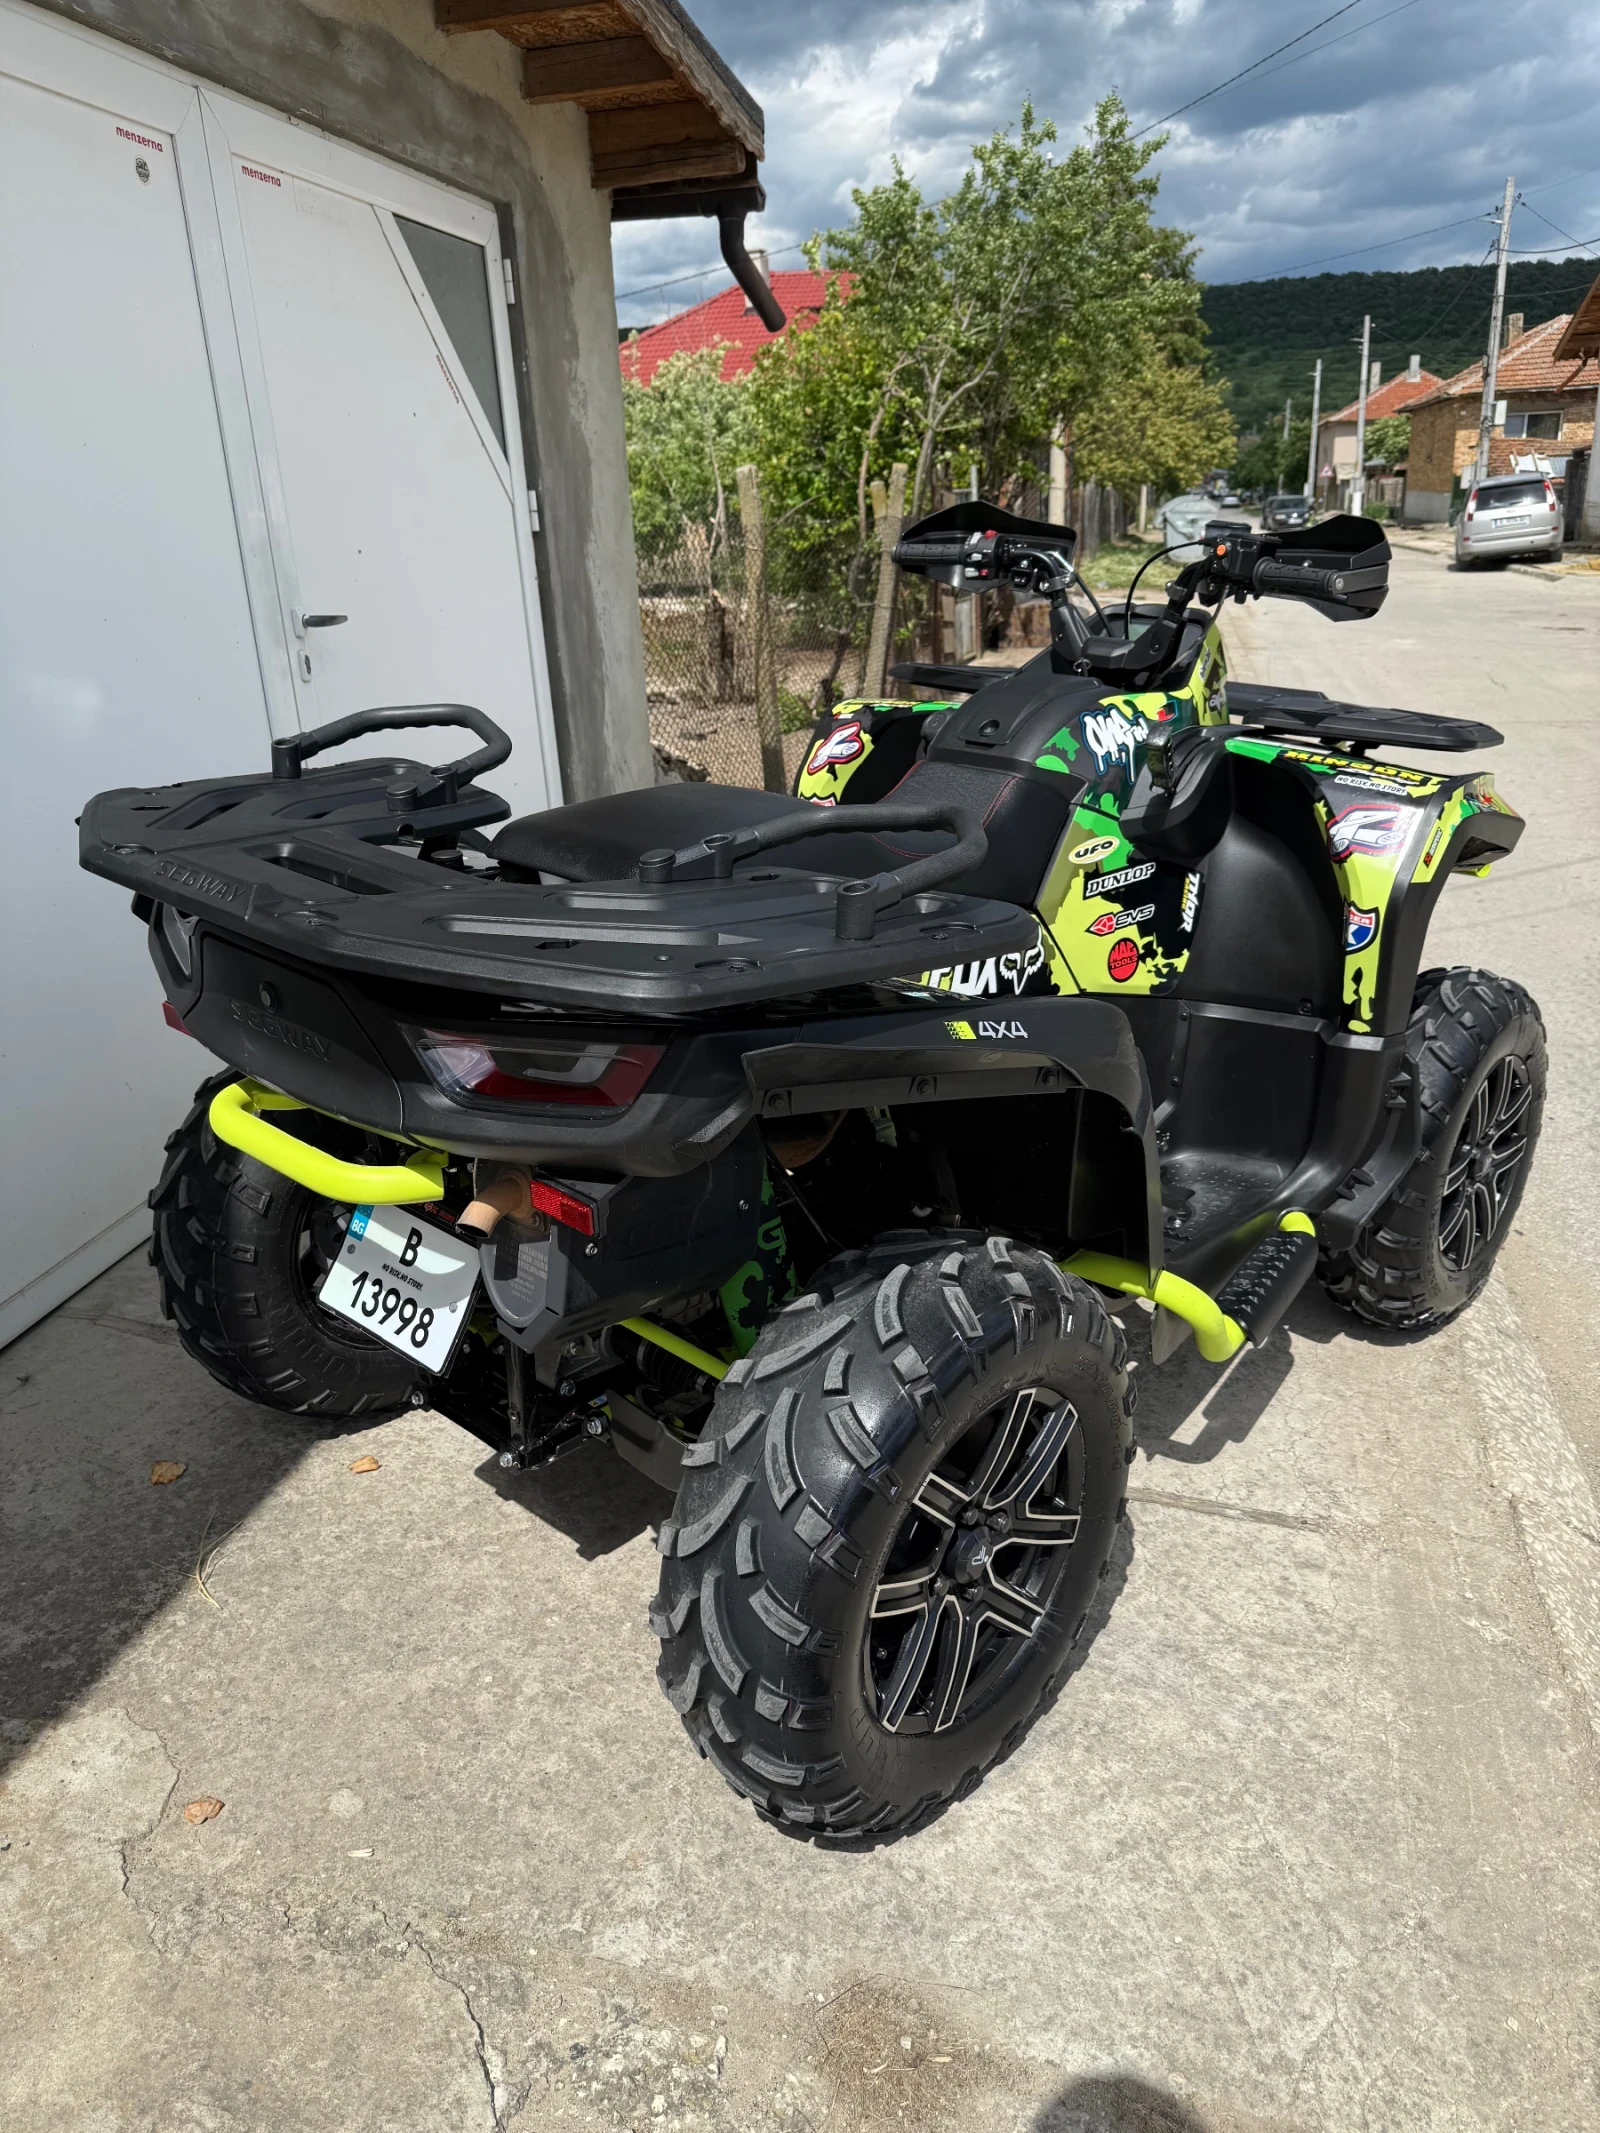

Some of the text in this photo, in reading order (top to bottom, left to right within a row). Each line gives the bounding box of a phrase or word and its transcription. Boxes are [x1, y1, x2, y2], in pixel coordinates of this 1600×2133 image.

[115, 126, 163, 152] menzerna
[241, 164, 282, 188] menzerna
[1337, 776, 1348, 784] NO
[1369, 782, 1380, 790] NO
[1075, 840, 1113, 858] UFO
[154, 860, 245, 901] SEGWAY
[1086, 862, 1156, 896] DUNLOP
[1177, 873, 1200, 932] THOR
[1115, 904, 1155, 928] EVS
[1110, 956, 1138, 969] TOOLS
[229, 999, 331, 1061] SEGWAY
[351, 1219, 365, 1235] BG
[399, 1227, 423, 1267] B
[351, 1271, 434, 1348] 13998
